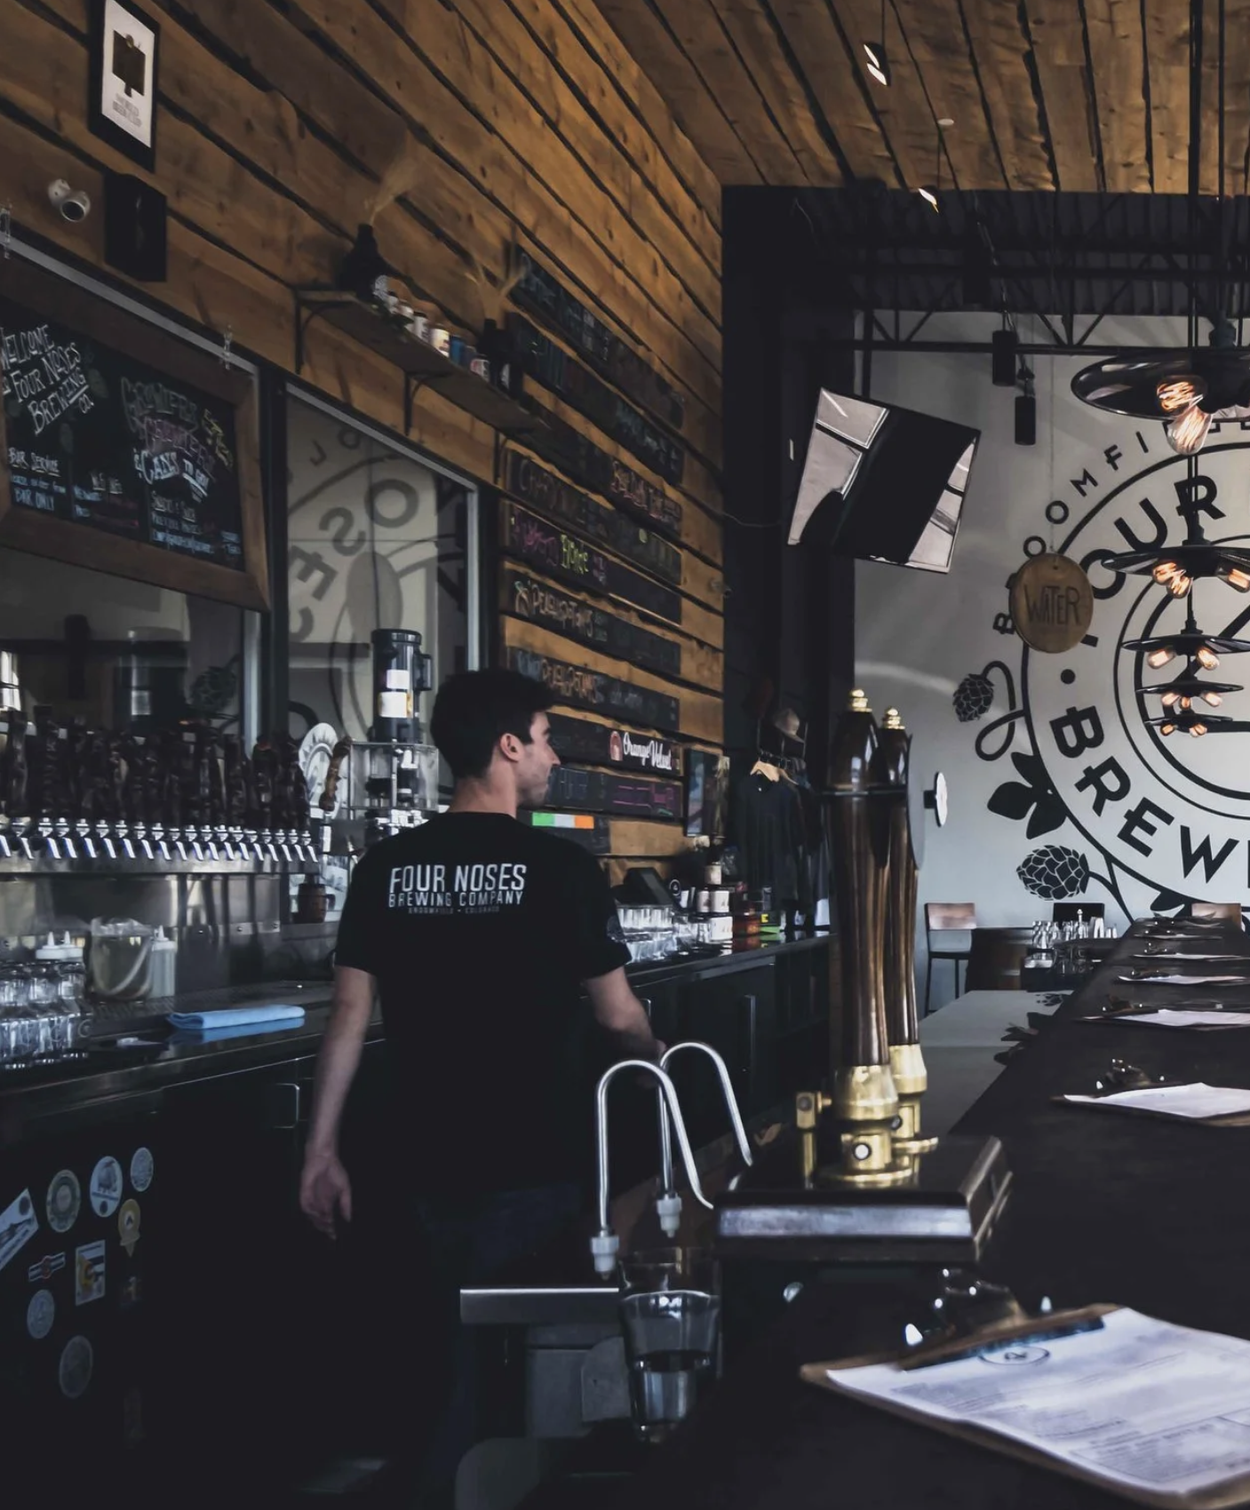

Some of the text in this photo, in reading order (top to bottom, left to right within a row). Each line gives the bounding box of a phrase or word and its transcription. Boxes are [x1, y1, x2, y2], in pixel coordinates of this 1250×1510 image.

[10, 369, 46, 403] FOUR
[41, 342, 80, 385] NOSES
[27, 366, 87, 436] BREWING
[141, 450, 180, 485] CANS
[1023, 584, 1081, 626] WATER
[389, 863, 527, 893] FOUR NOSES
[389, 891, 523, 908] BREWING COMPANY
